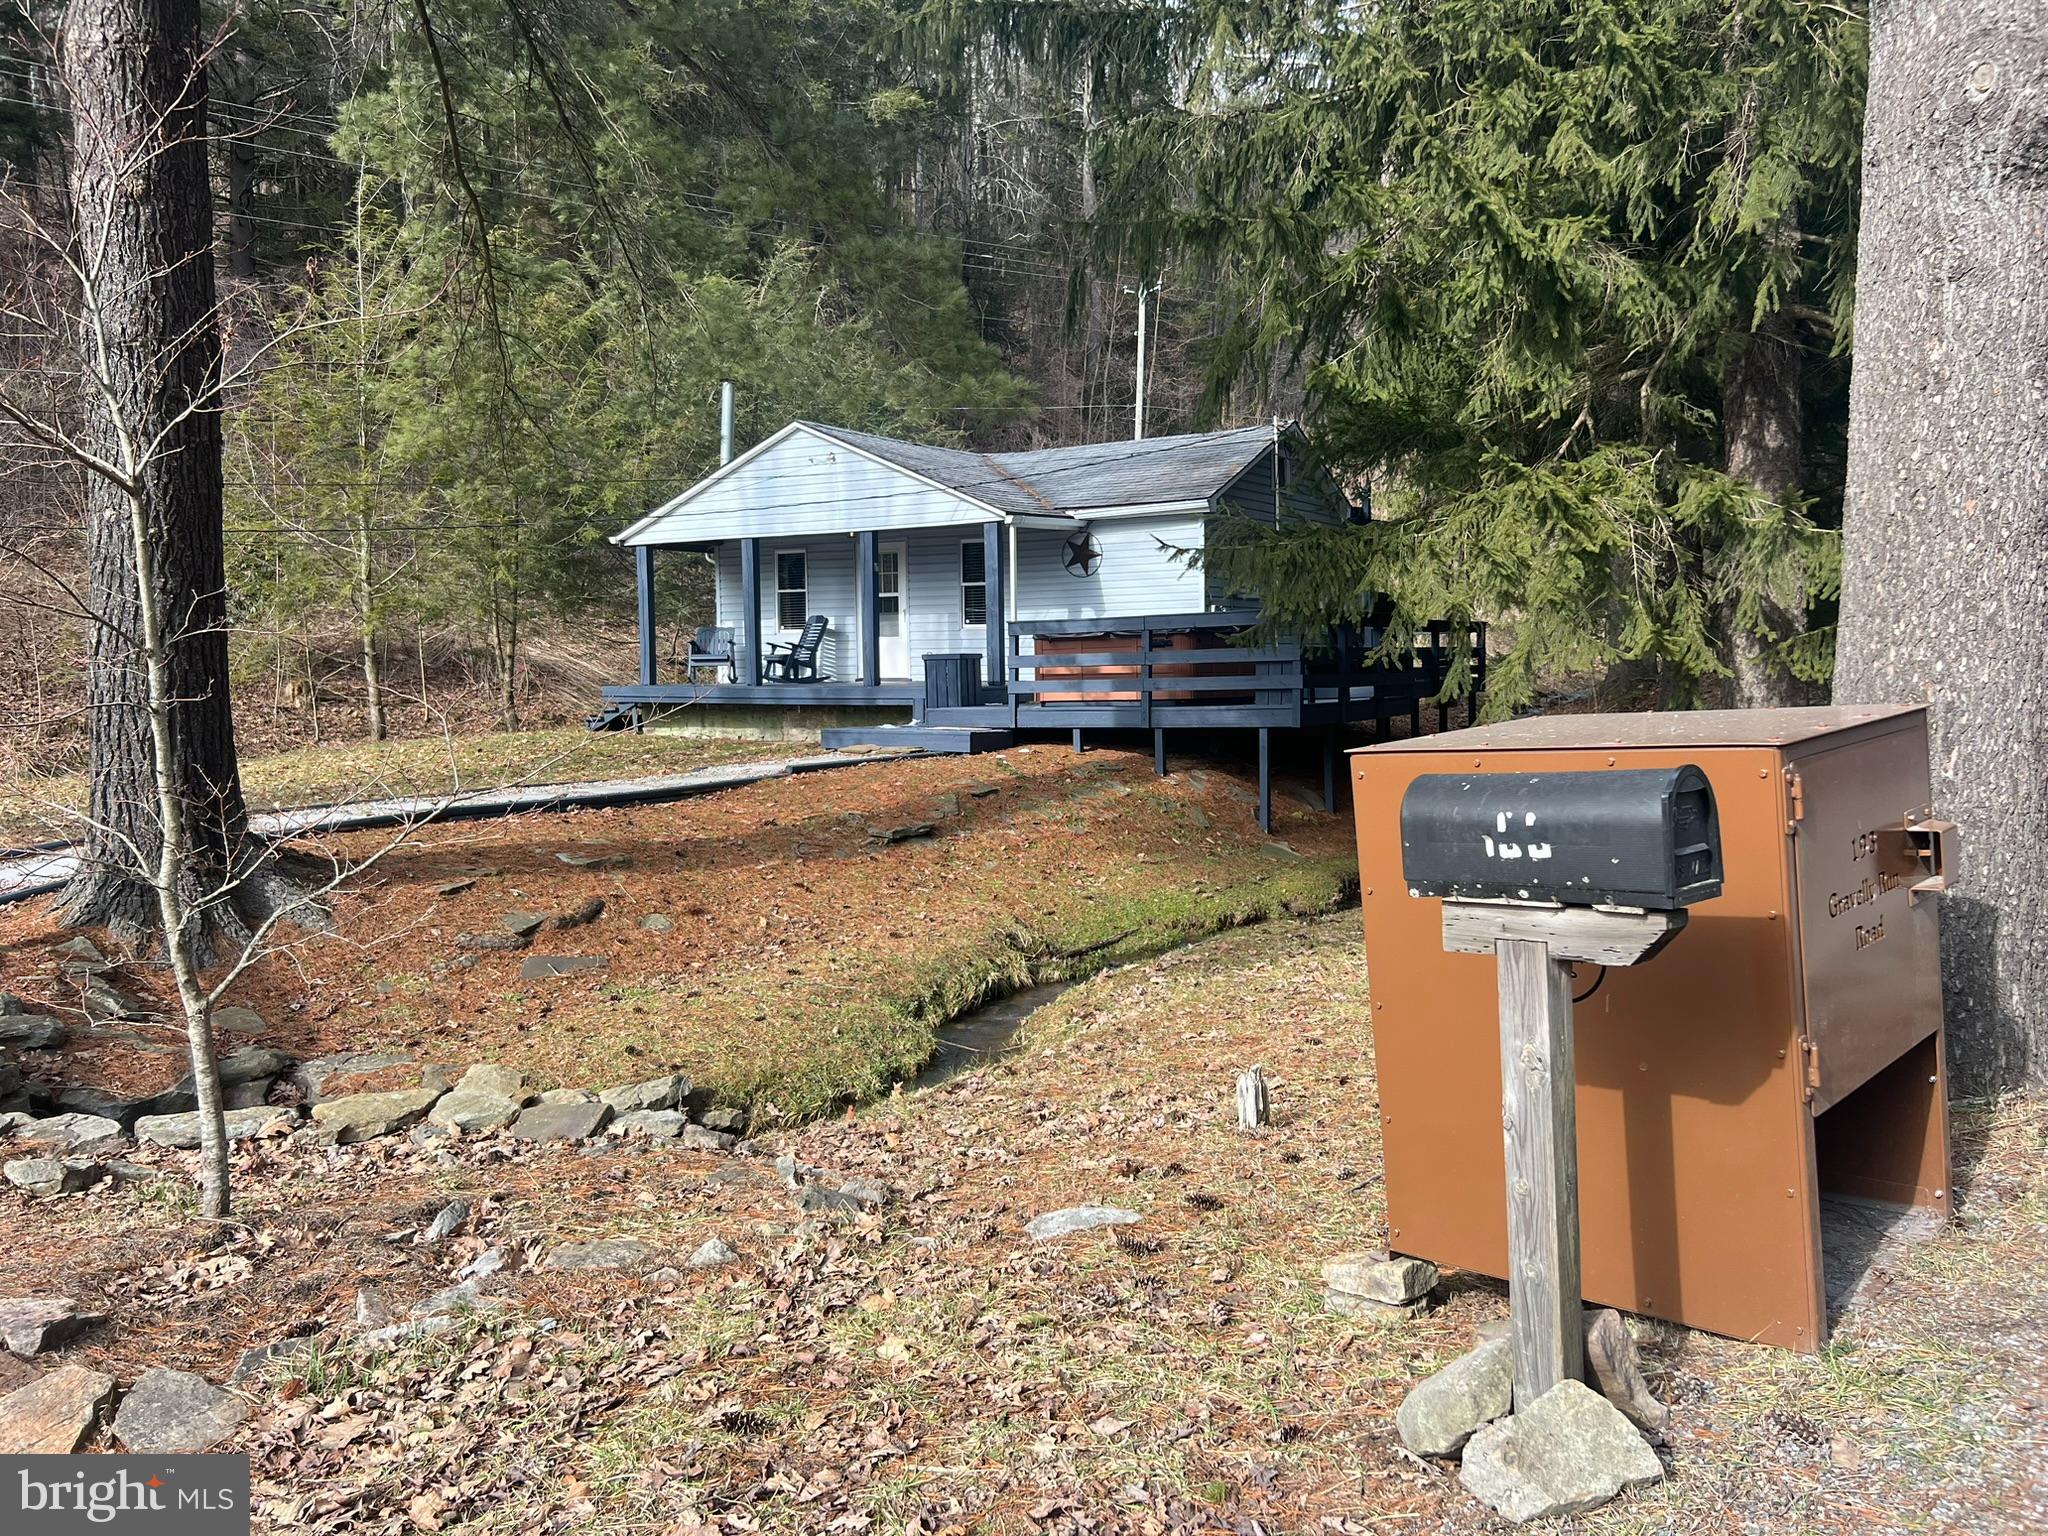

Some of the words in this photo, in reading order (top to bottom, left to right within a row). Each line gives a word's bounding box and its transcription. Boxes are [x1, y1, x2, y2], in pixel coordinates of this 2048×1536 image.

[1828, 878, 1875, 918] Gravelly
[1878, 871, 1899, 896] Run
[1855, 914, 1885, 951] Road
